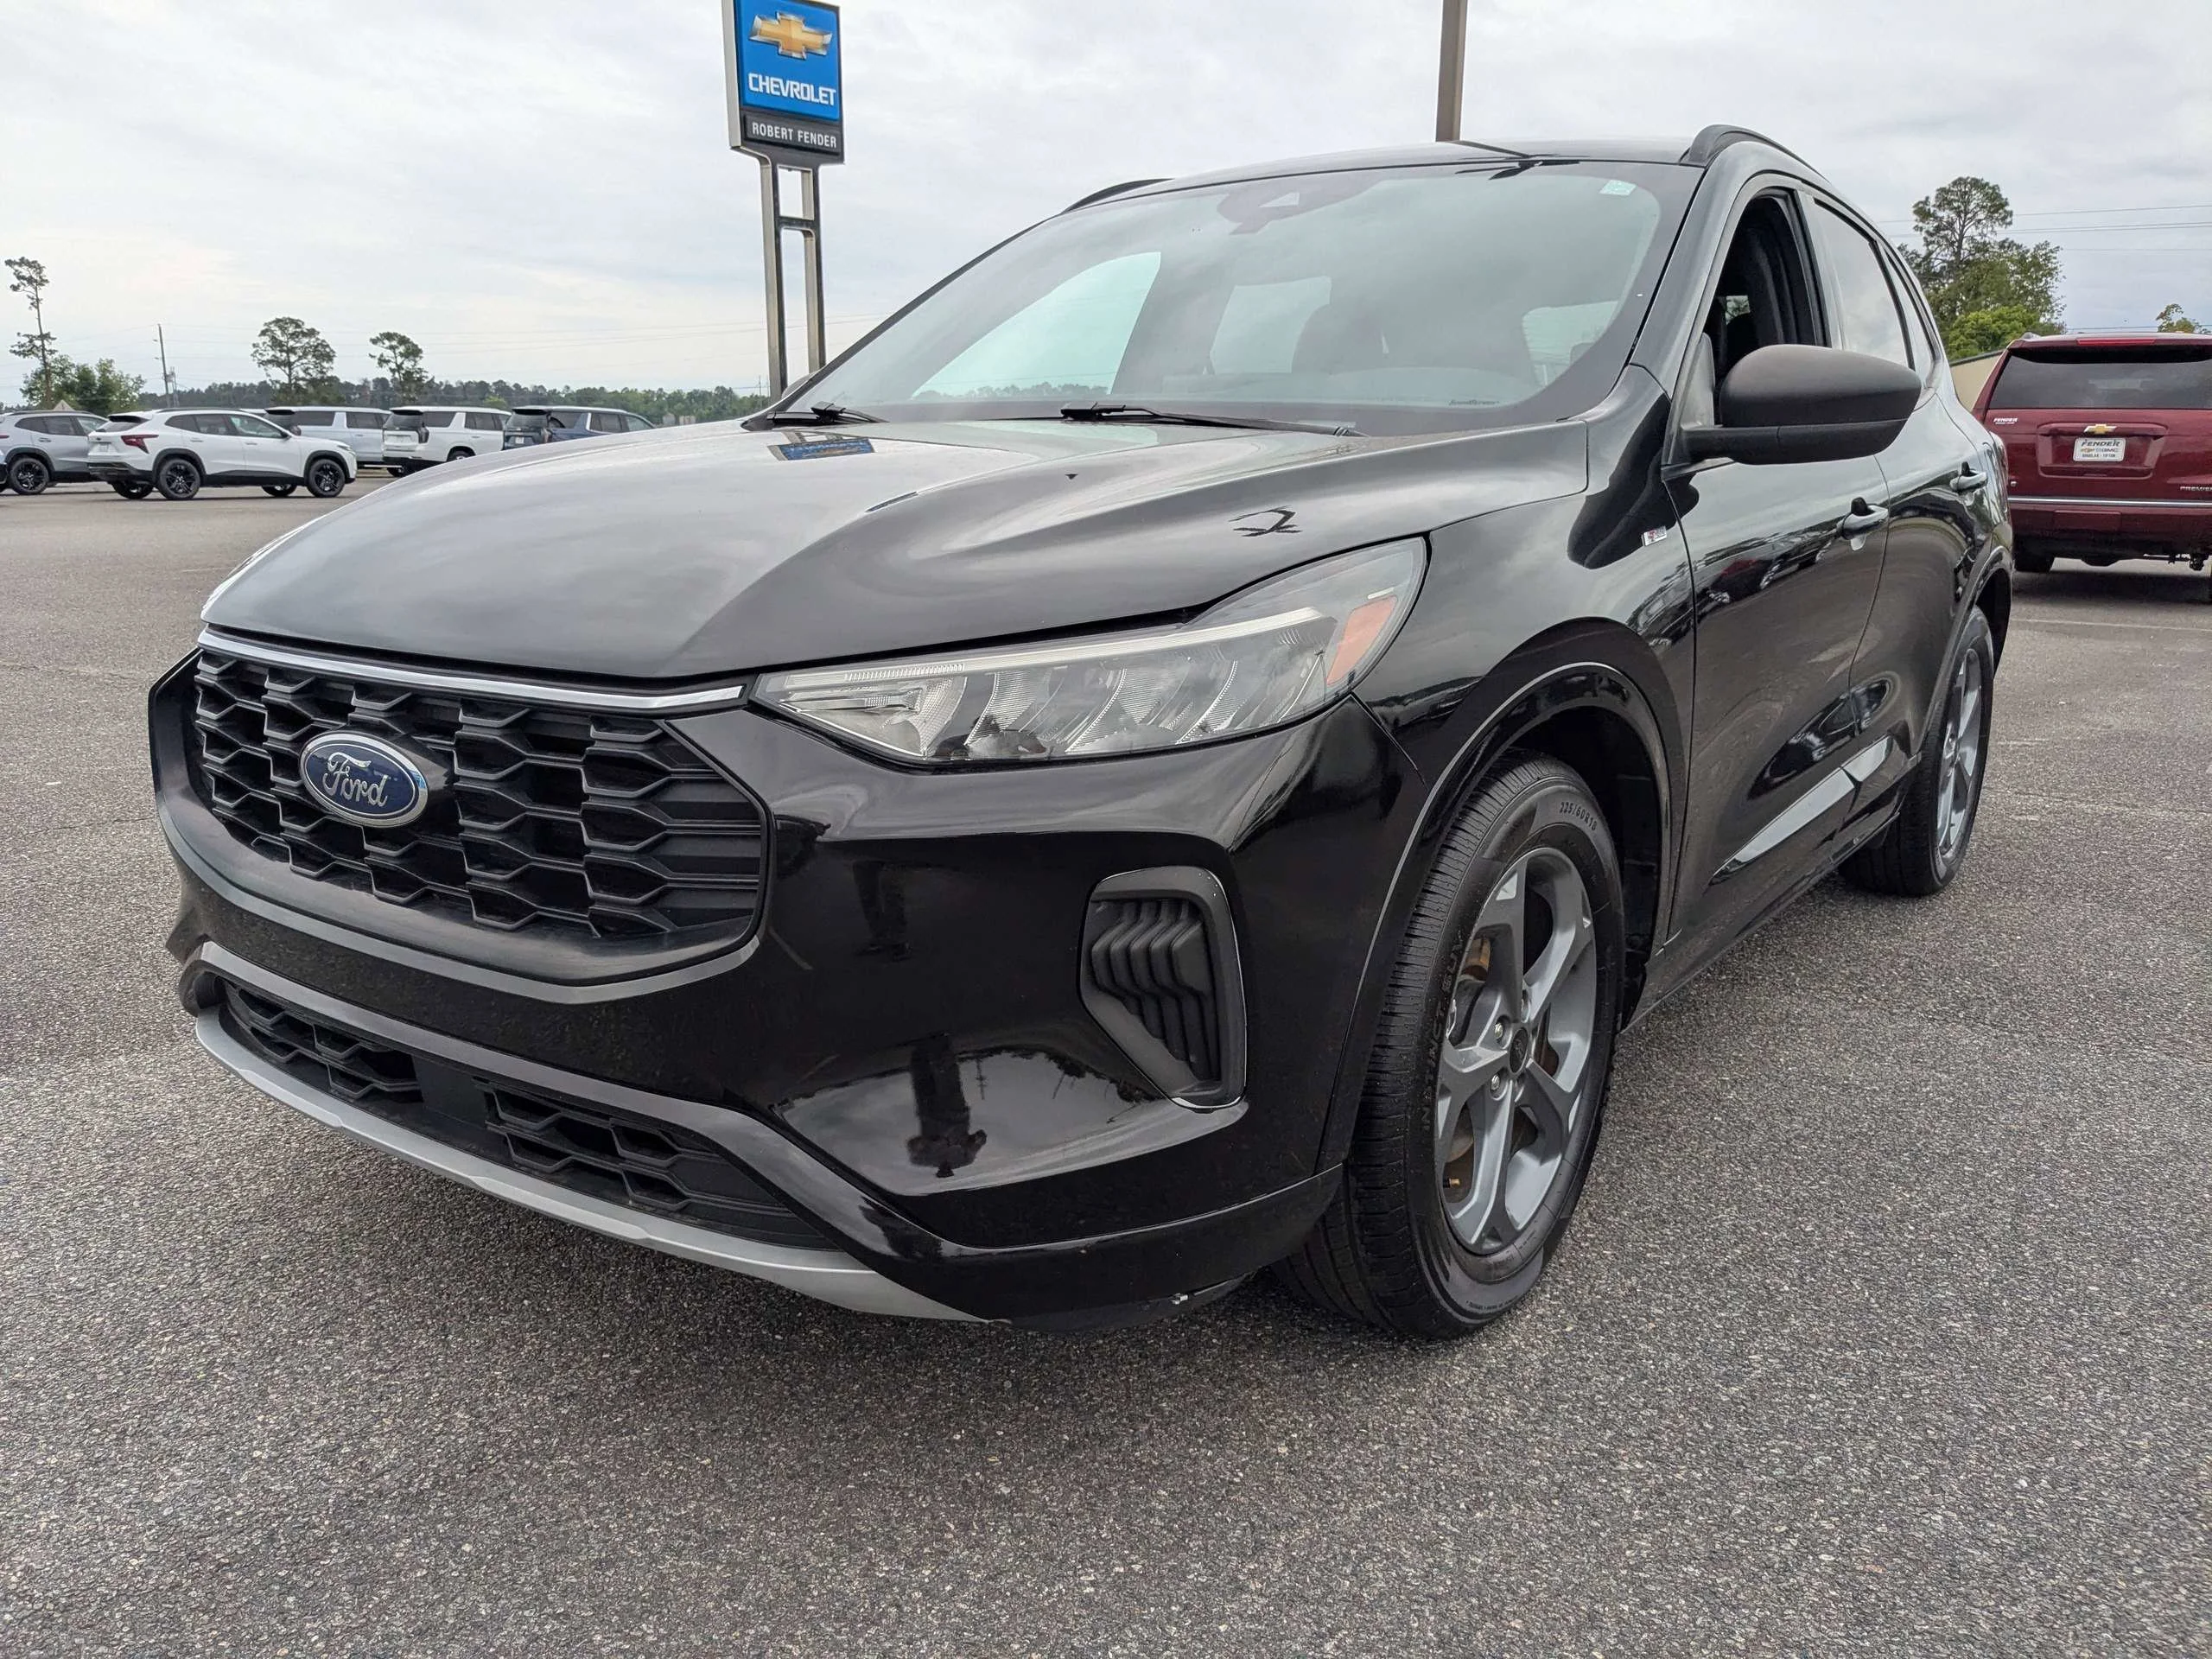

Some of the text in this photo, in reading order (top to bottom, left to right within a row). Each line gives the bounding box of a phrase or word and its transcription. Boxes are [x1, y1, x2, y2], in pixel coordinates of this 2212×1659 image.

[748, 73, 836, 105] CHEVROLET
[752, 122, 837, 149] ROBERT FENDER
[321, 751, 389, 808] Ford
